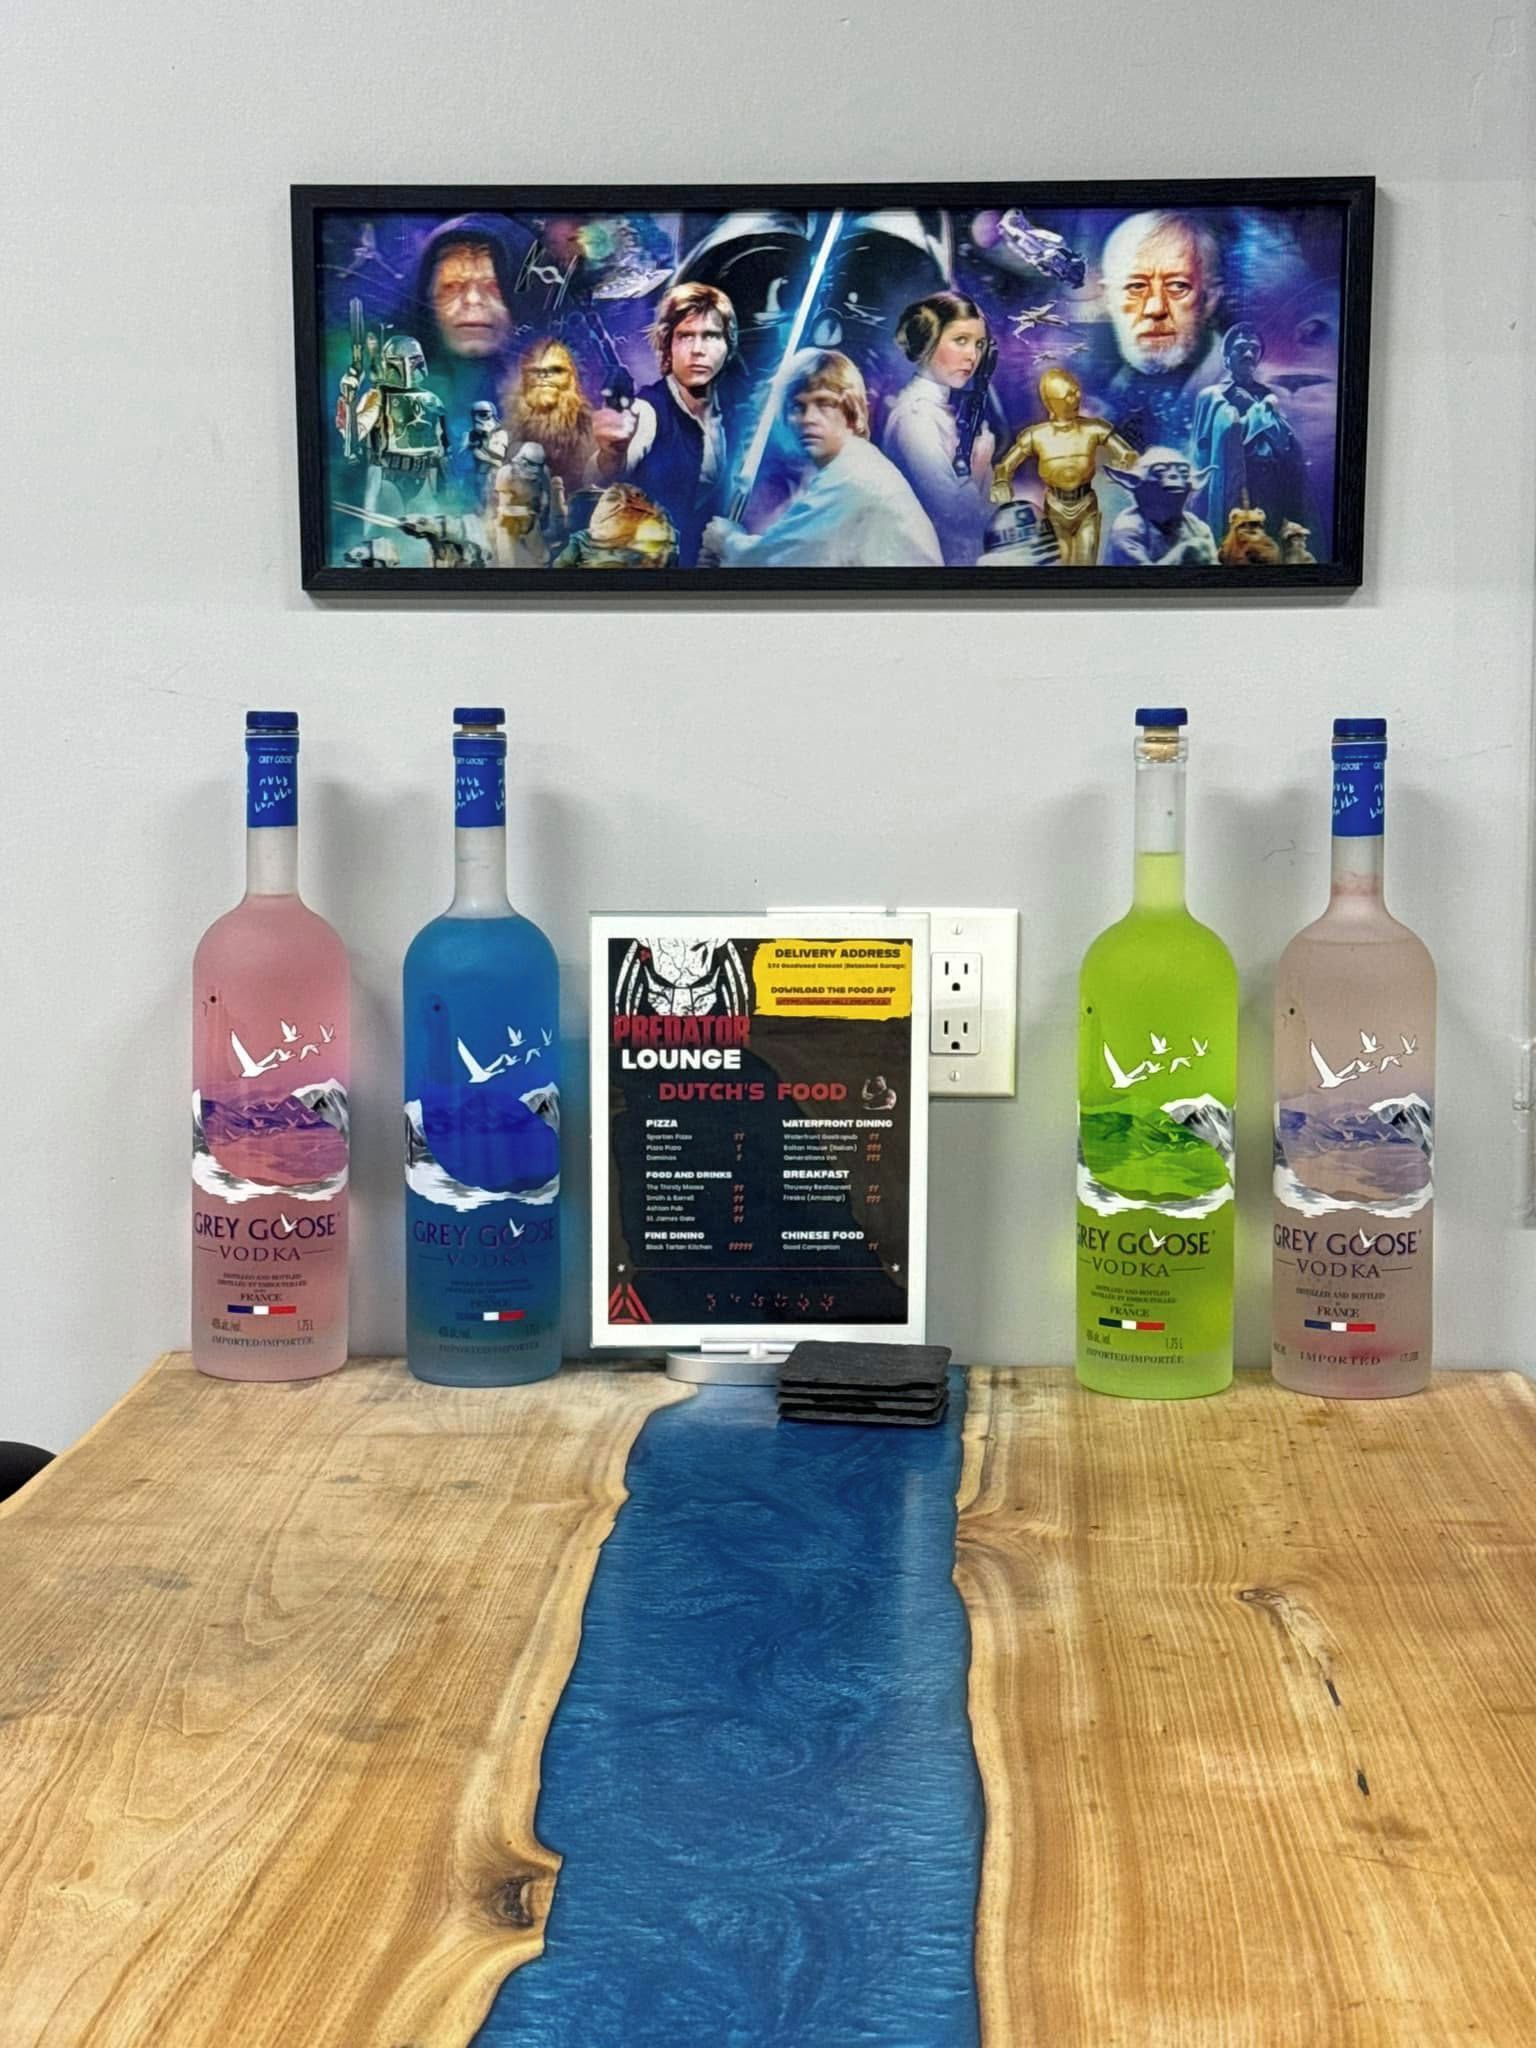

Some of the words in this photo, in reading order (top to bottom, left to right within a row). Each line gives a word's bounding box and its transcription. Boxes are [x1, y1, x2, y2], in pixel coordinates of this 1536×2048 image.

[775, 948, 837, 958] DELIVERY
[840, 949, 900, 958] ADDRESS
[771, 986, 825, 994] DOWNLOAD
[613, 1015, 751, 1047] PREDATOR
[622, 1049, 741, 1070] LOUNGE
[659, 1083, 765, 1101] DUTCH'S
[777, 1082, 848, 1101] FOOD
[645, 1119, 678, 1128] PIZZA
[782, 1119, 855, 1128] WATERFRONT
[855, 1119, 894, 1128] DINING
[645, 1171, 672, 1179] FOOD
[673, 1171, 695, 1179] AND
[695, 1171, 733, 1179] DRINKS
[783, 1170, 850, 1179] BREAKFAST
[194, 1211, 240, 1240] GREY
[248, 1213, 337, 1240] GOOSE
[414, 1220, 470, 1248] GREY
[645, 1231, 668, 1240] FINE
[669, 1231, 705, 1240] DINING
[781, 1231, 831, 1240] CHINESE
[832, 1231, 864, 1240] FOOD
[1273, 1223, 1317, 1254] GREY
[1326, 1231, 1418, 1257] GOOSE
[1117, 1231, 1210, 1256] GOOSE
[219, 1245, 302, 1262] VODKA
[1092, 1256, 1170, 1278] VODKA
[1296, 1258, 1380, 1279] VODKA
[240, 1293, 283, 1302] FRANCE
[1333, 1291, 1349, 1299] AND
[1110, 1305, 1151, 1318] FRANCE
[1317, 1305, 1360, 1318] FRANCE
[1300, 1350, 1381, 1366] IMPORTED
